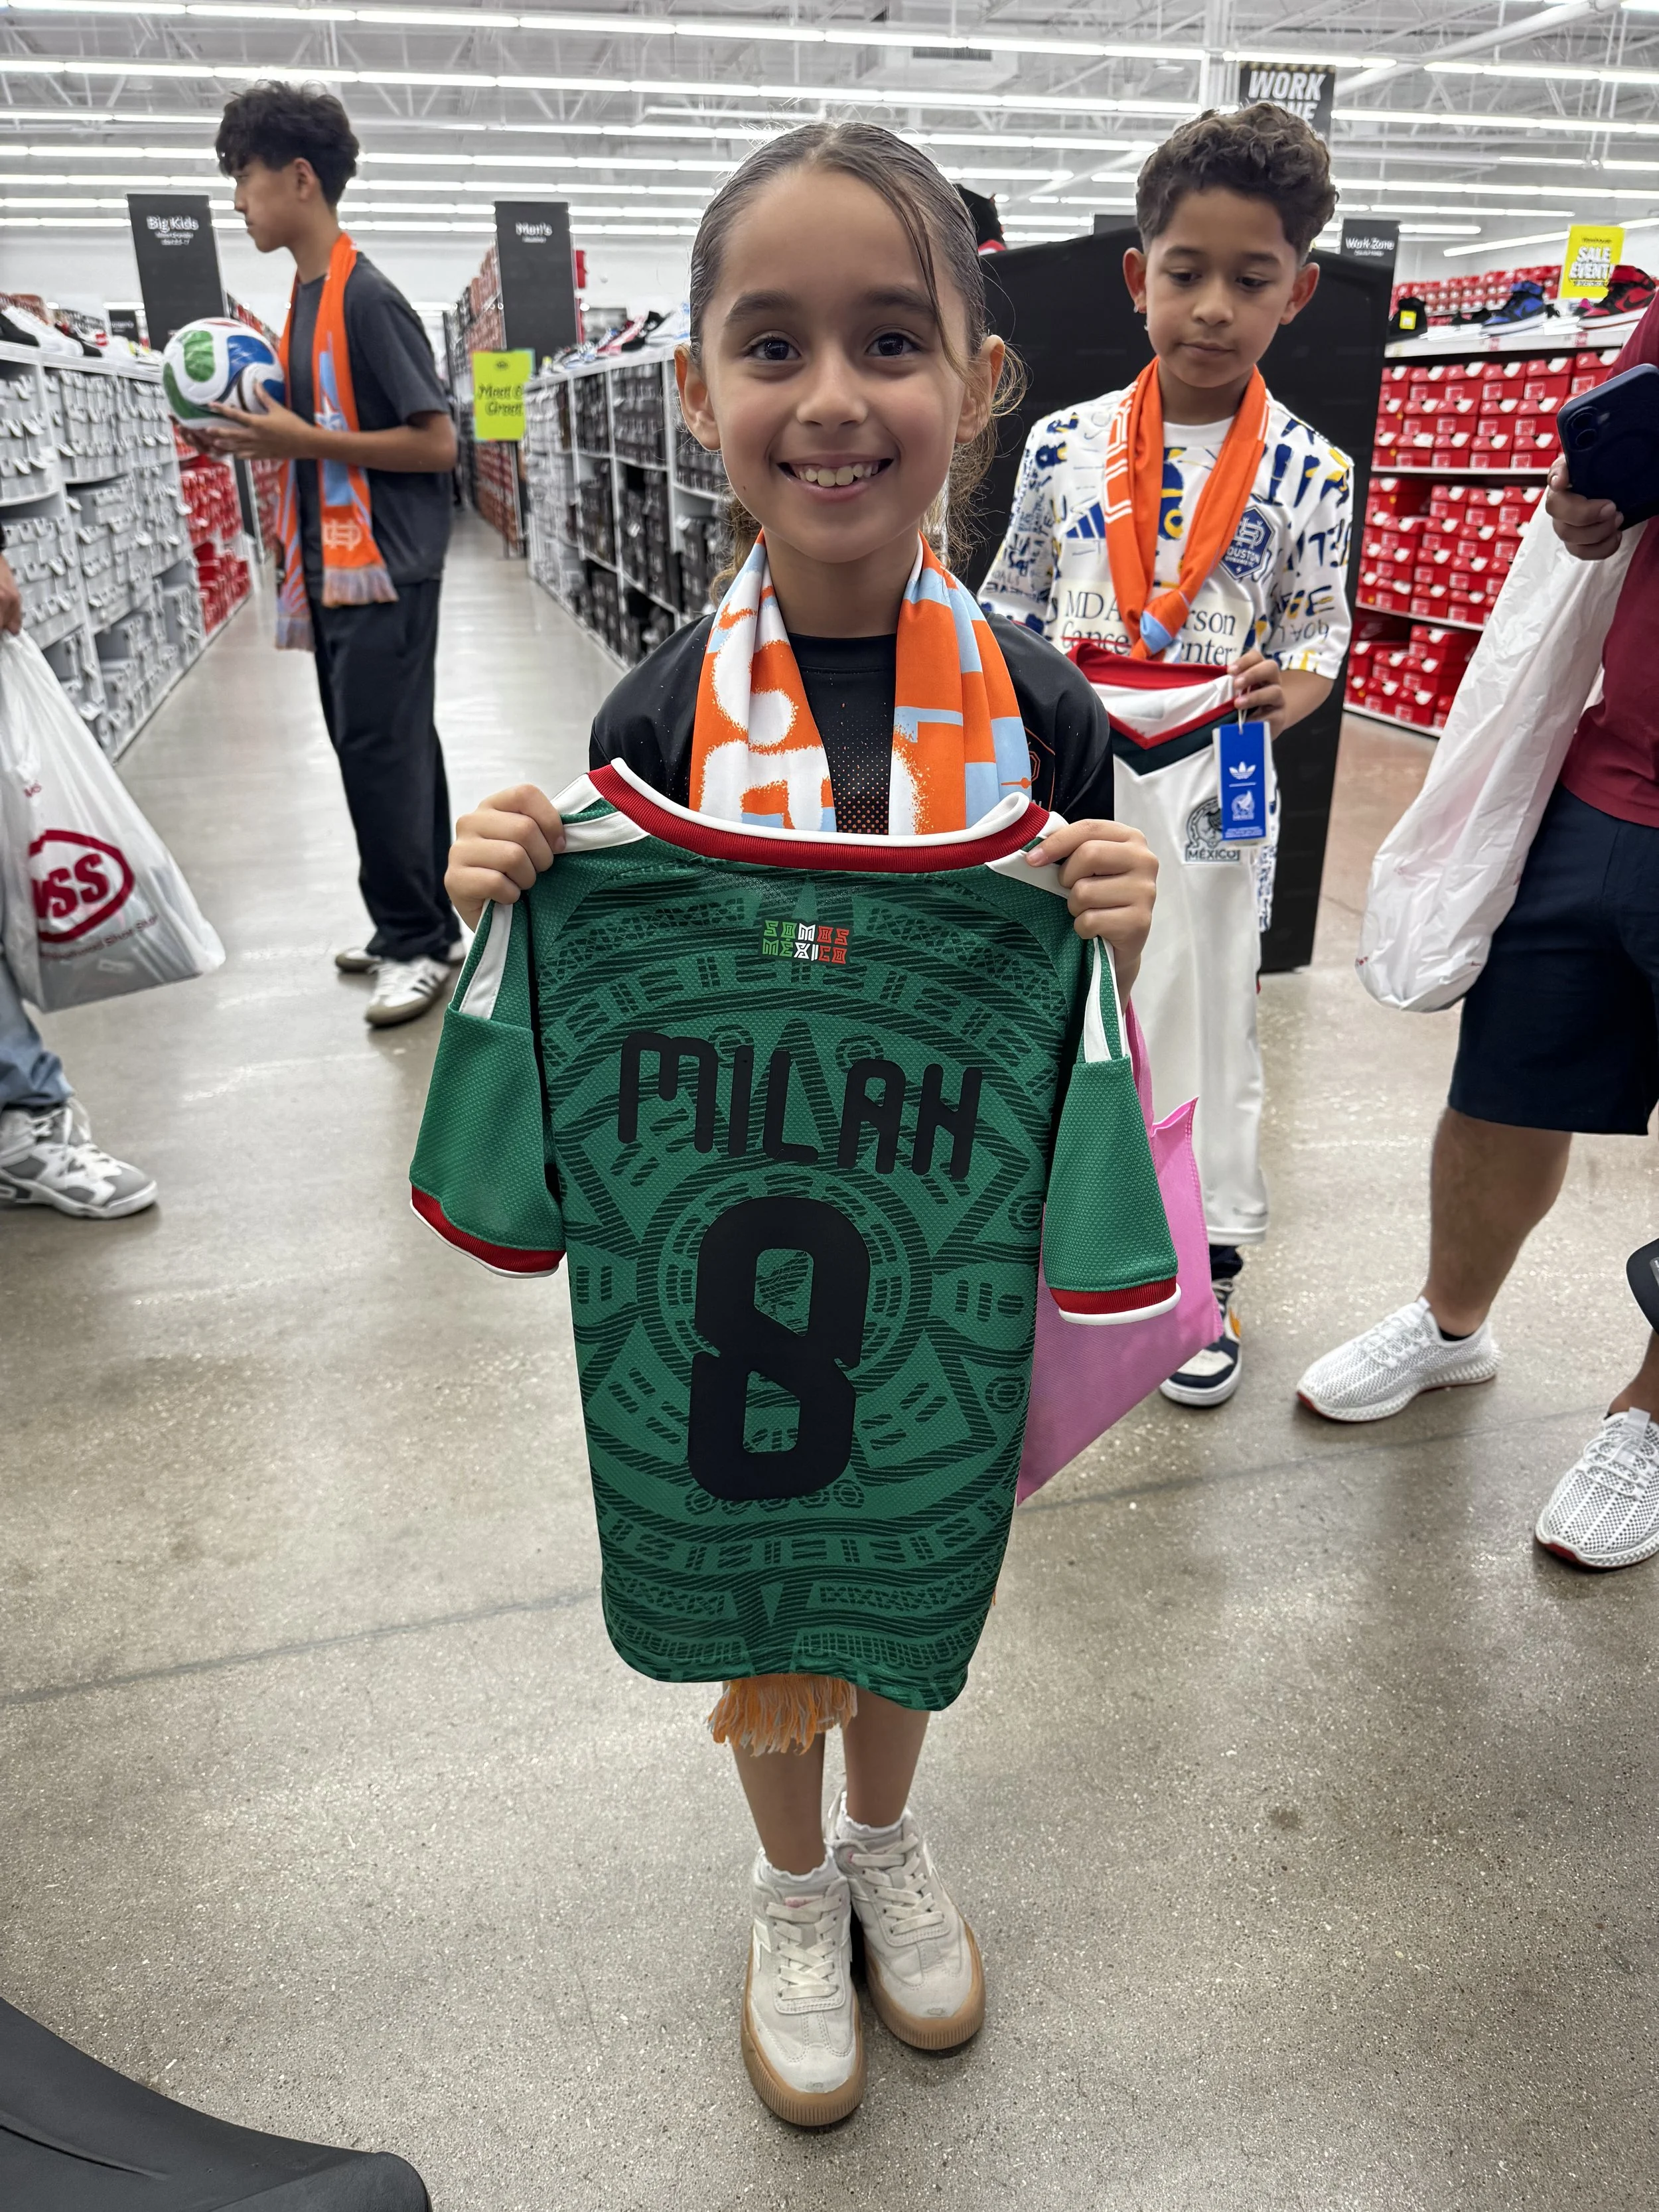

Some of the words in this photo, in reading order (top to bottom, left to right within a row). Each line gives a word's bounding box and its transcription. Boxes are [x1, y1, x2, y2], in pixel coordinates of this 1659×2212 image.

[1248, 70, 1327, 101] WORK
[146, 215, 170, 233] Big
[170, 215, 199, 230] Kids
[1345, 237, 1370, 249] Work
[1370, 237, 1395, 250] Zone
[1577, 246, 1611, 263] SALE
[1226, 546, 1260, 564] OUSTON
[1065, 591, 1104, 619] MD
[764, 920, 849, 946] SOMOS
[687, 1196, 871, 1501] 8
